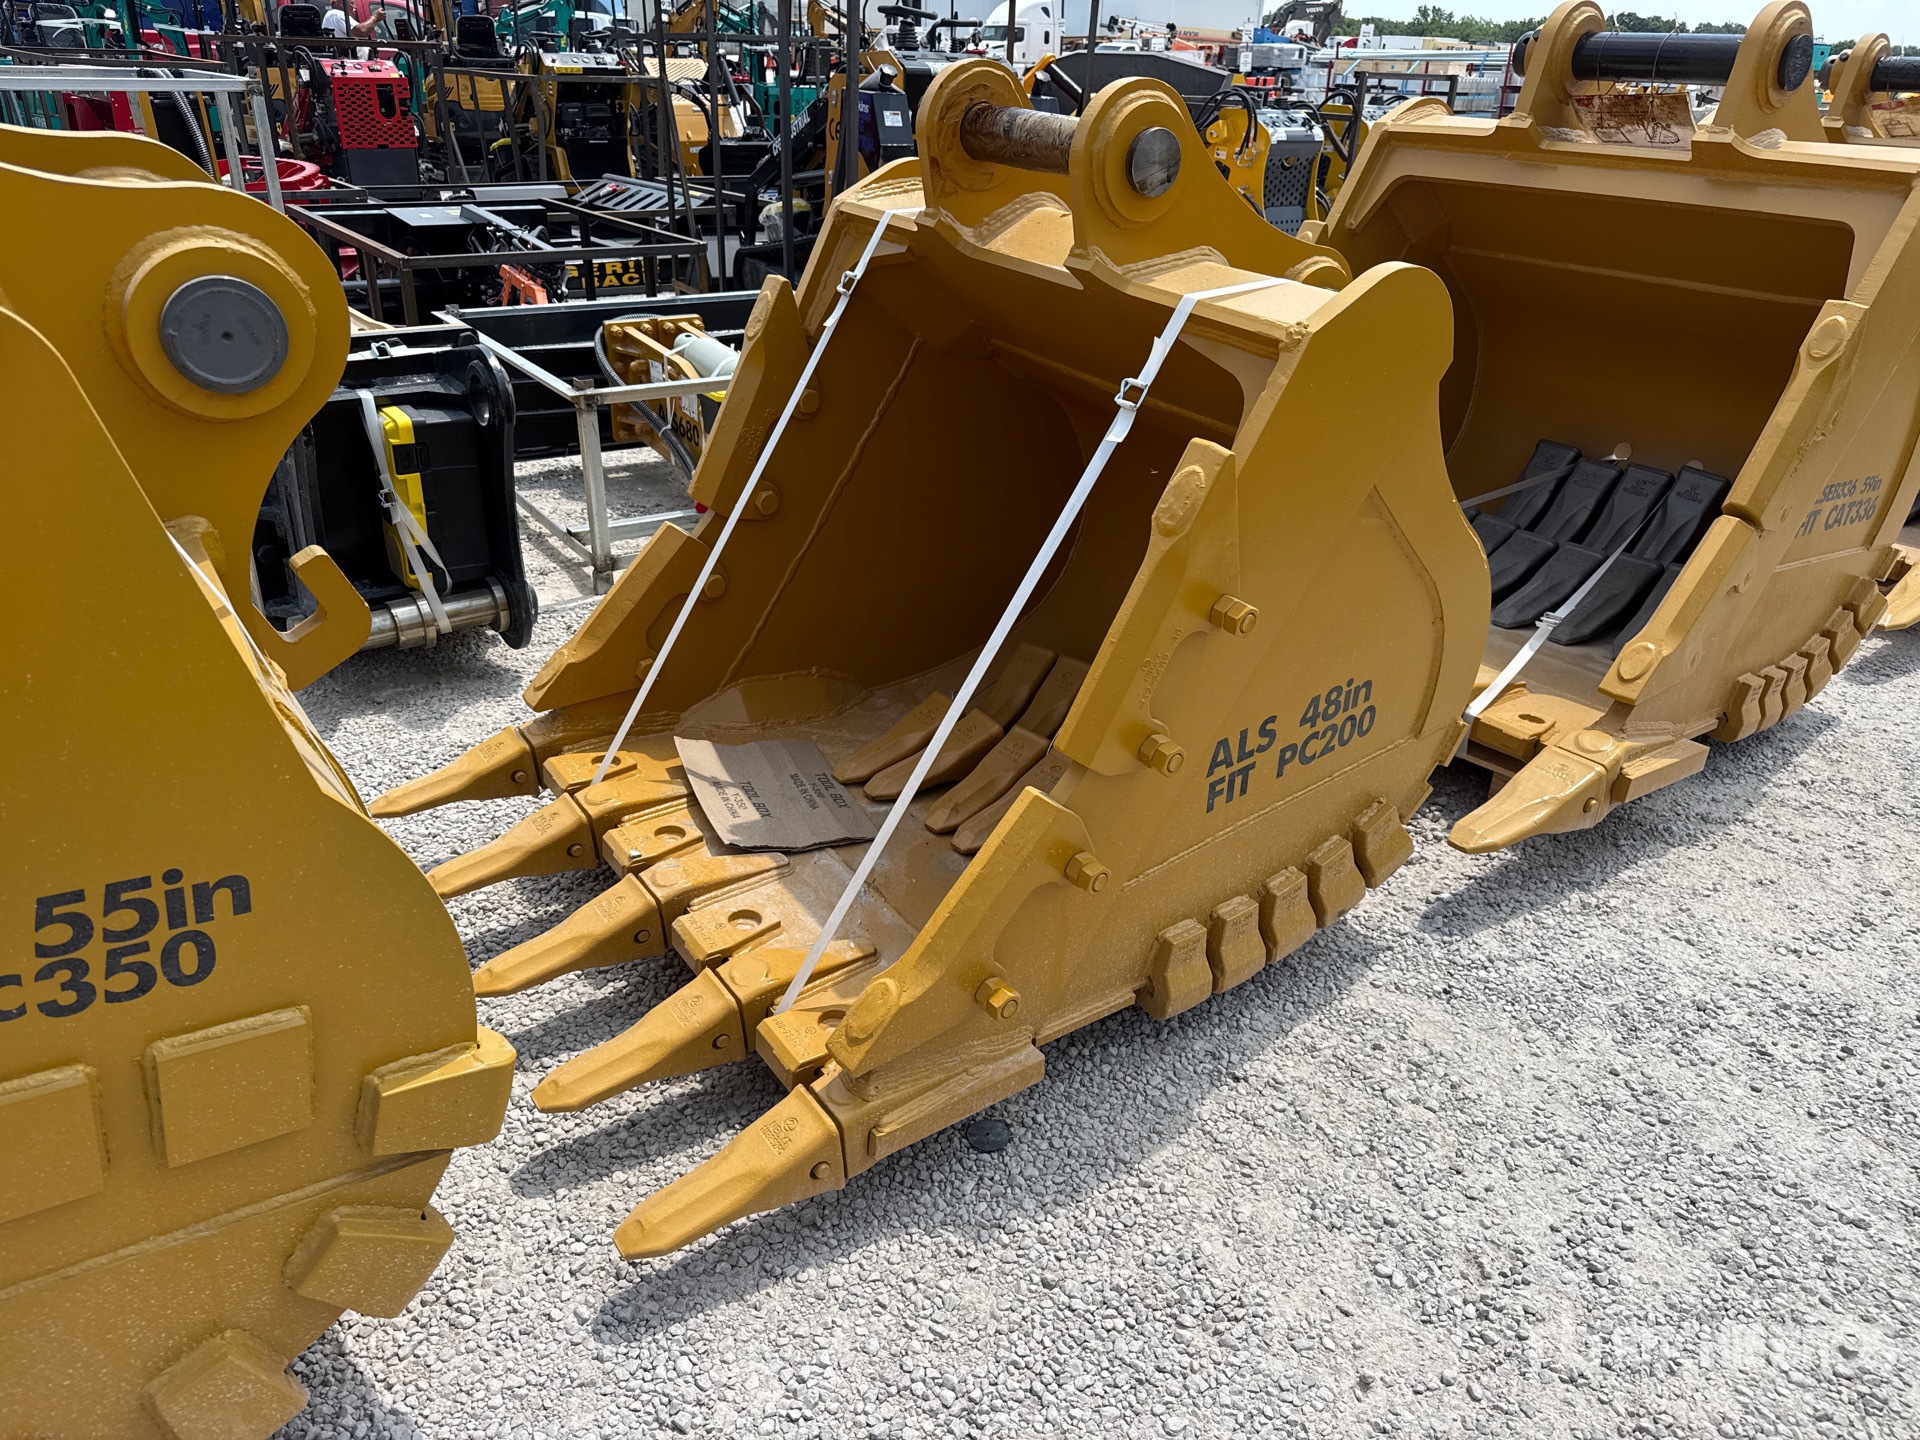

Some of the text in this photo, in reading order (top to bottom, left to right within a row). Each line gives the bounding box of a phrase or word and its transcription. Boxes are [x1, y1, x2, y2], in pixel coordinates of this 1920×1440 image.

[1824, 495, 1880, 531] CAT336
[1205, 678, 1373, 779] ALS 48in
[1205, 705, 1377, 814] FIT PC200
[712, 780, 725, 797] MADE
[724, 802, 741, 819] CHINA
[731, 792, 748, 810] Y-350
[739, 780, 774, 819] TOOL BOX
[789, 773, 806, 791] MADE
[803, 792, 820, 811] CHINA
[815, 772, 851, 809] TOOL BOX
[34, 868, 252, 959] 55in
[0, 929, 217, 1022] C350
